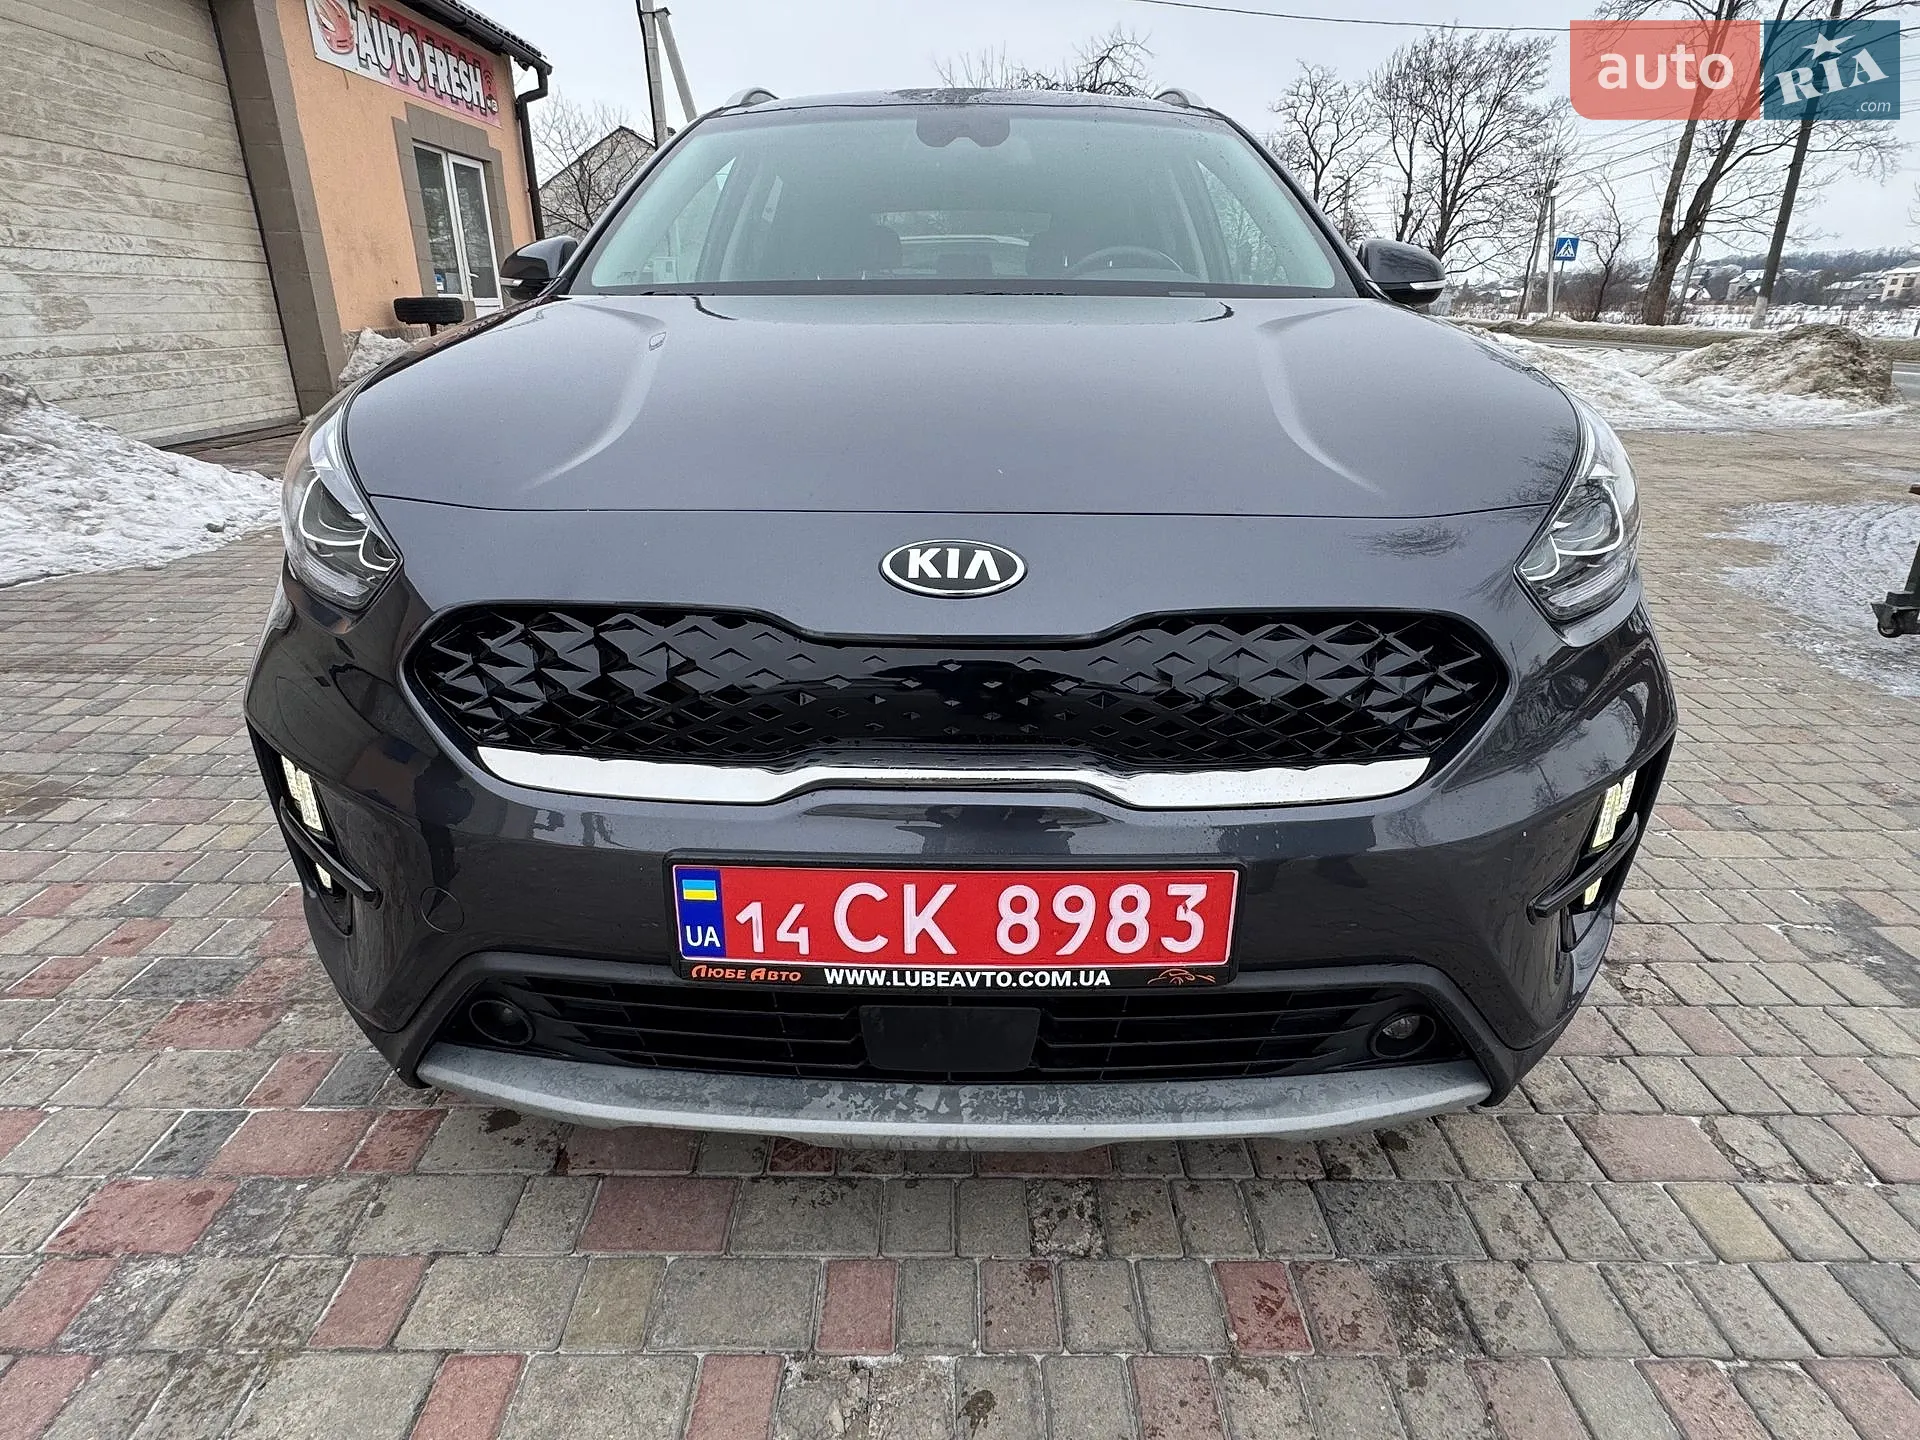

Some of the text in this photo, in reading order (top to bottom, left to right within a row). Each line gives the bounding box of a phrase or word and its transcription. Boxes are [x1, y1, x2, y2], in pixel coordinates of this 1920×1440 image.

[356, 9, 487, 110] AUTO FRESH
[907, 547, 1001, 582] KIA
[685, 924, 721, 948] UA
[734, 881, 1209, 956] 14 CK 8983
[823, 967, 1111, 988] WWW.LUBEAVTO.COM.UA
